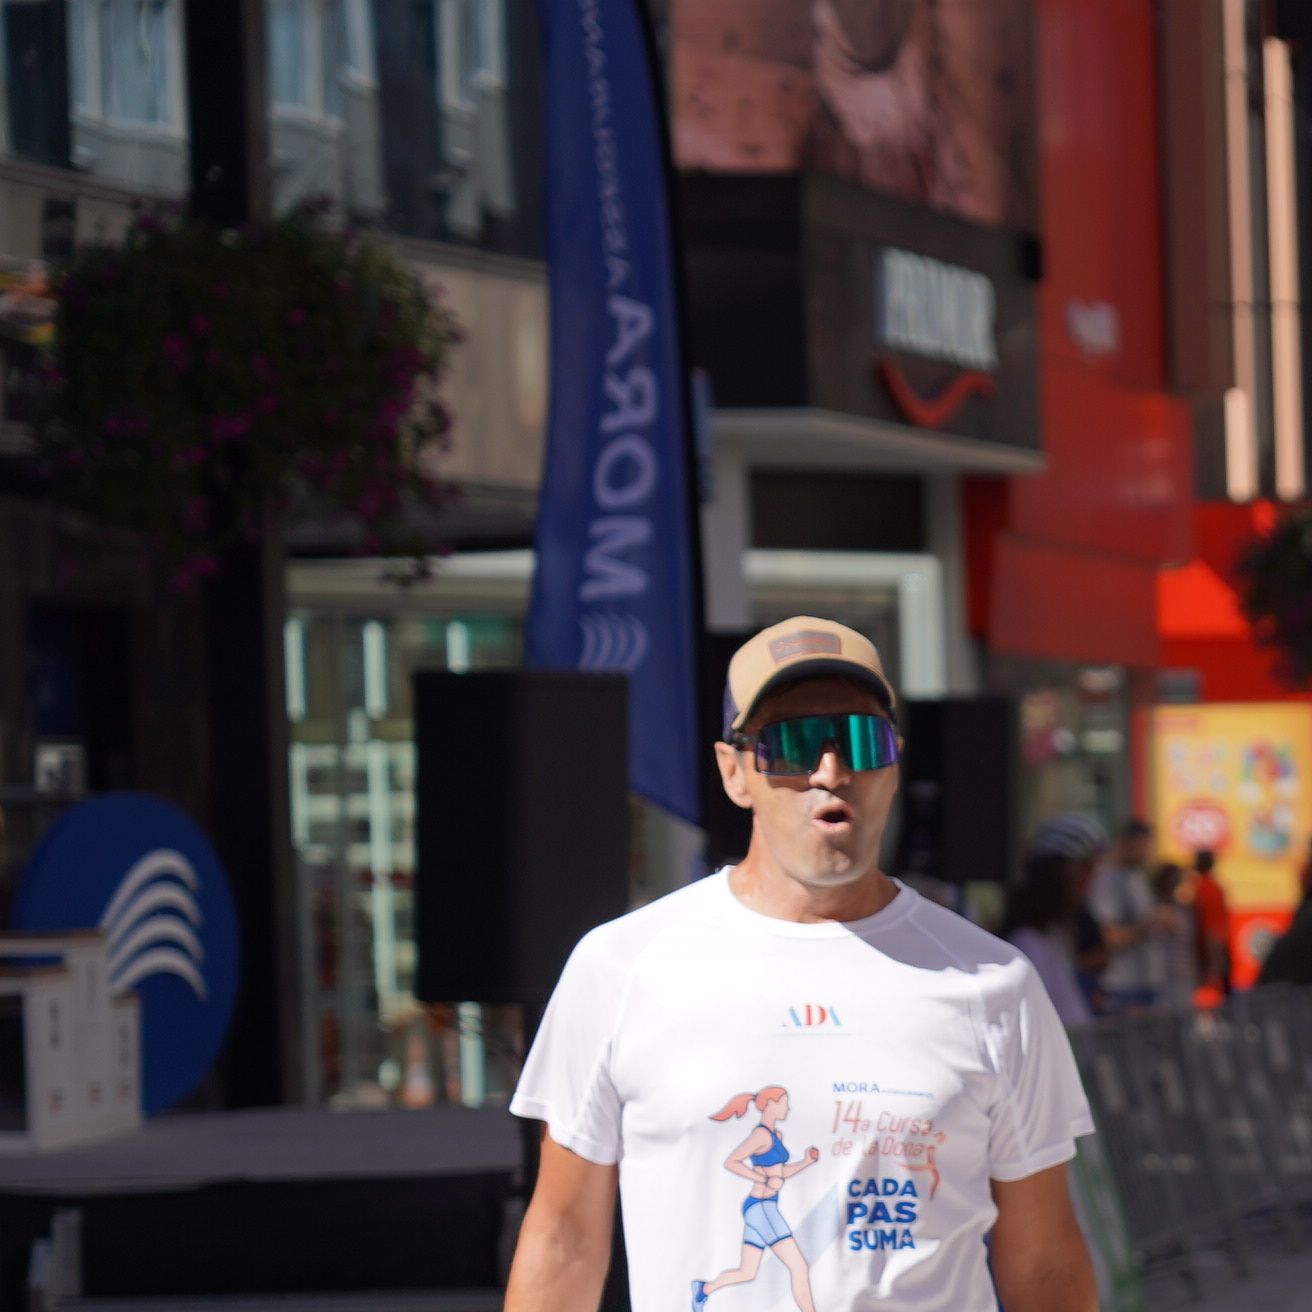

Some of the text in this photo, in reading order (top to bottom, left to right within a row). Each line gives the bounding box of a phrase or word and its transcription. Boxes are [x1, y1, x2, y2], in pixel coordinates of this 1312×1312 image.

[781, 1003, 842, 1028] ADA
[832, 1082, 881, 1093] MORA
[876, 1111, 933, 1135] Cursa
[832, 1136, 854, 1157] de
[881, 1136, 924, 1158] Dona
[847, 1177, 918, 1198] CADA
[846, 1201, 917, 1225] PAS
[848, 1228, 916, 1251] SUMA
